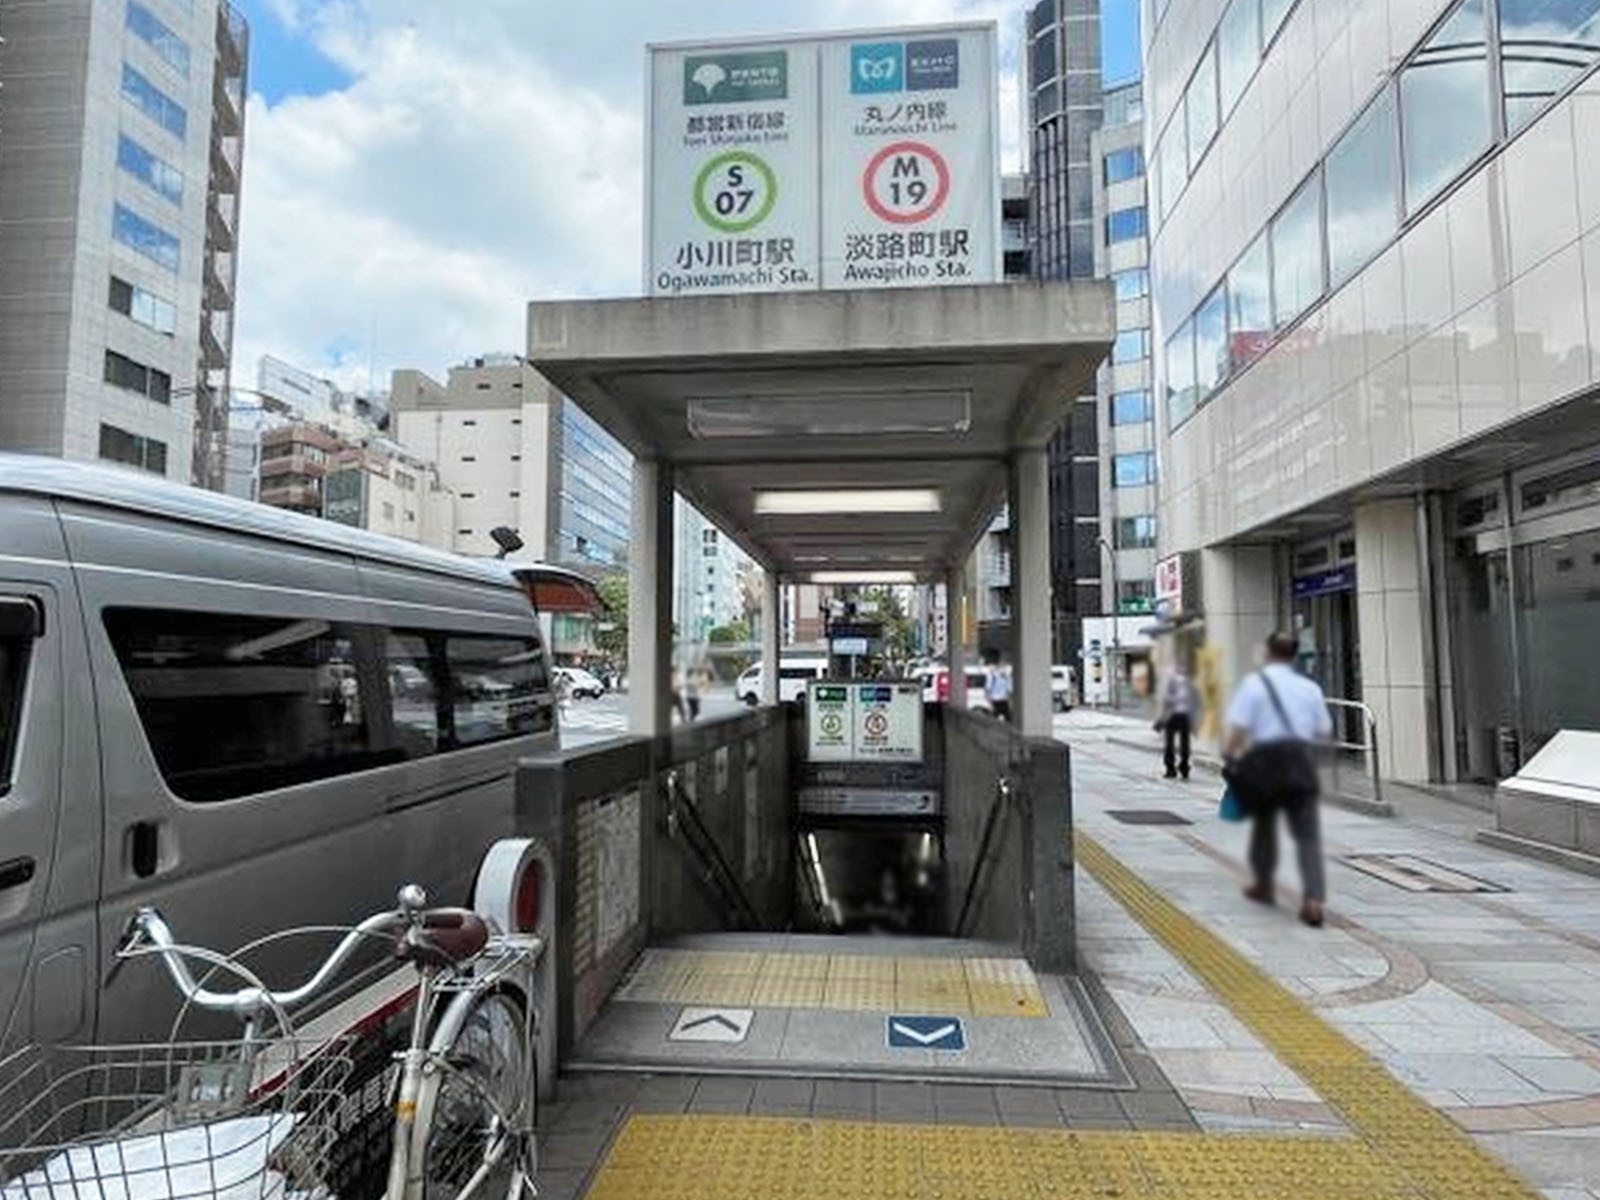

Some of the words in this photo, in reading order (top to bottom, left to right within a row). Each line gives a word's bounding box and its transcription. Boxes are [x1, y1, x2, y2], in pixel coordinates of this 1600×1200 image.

[864, 101, 948, 122] 丸ノ内線
[727, 165, 743, 187] S
[892, 156, 920, 178] M
[715, 190, 754, 215] 07
[889, 181, 927, 205] 19
[676, 238, 795, 270] 小川町駅
[845, 230, 969, 261] 淡路町駅
[657, 267, 773, 292] Ogawamachi
[779, 266, 814, 285] Sta.
[844, 261, 929, 282] Awajicho
[935, 260, 972, 278] Sta.
